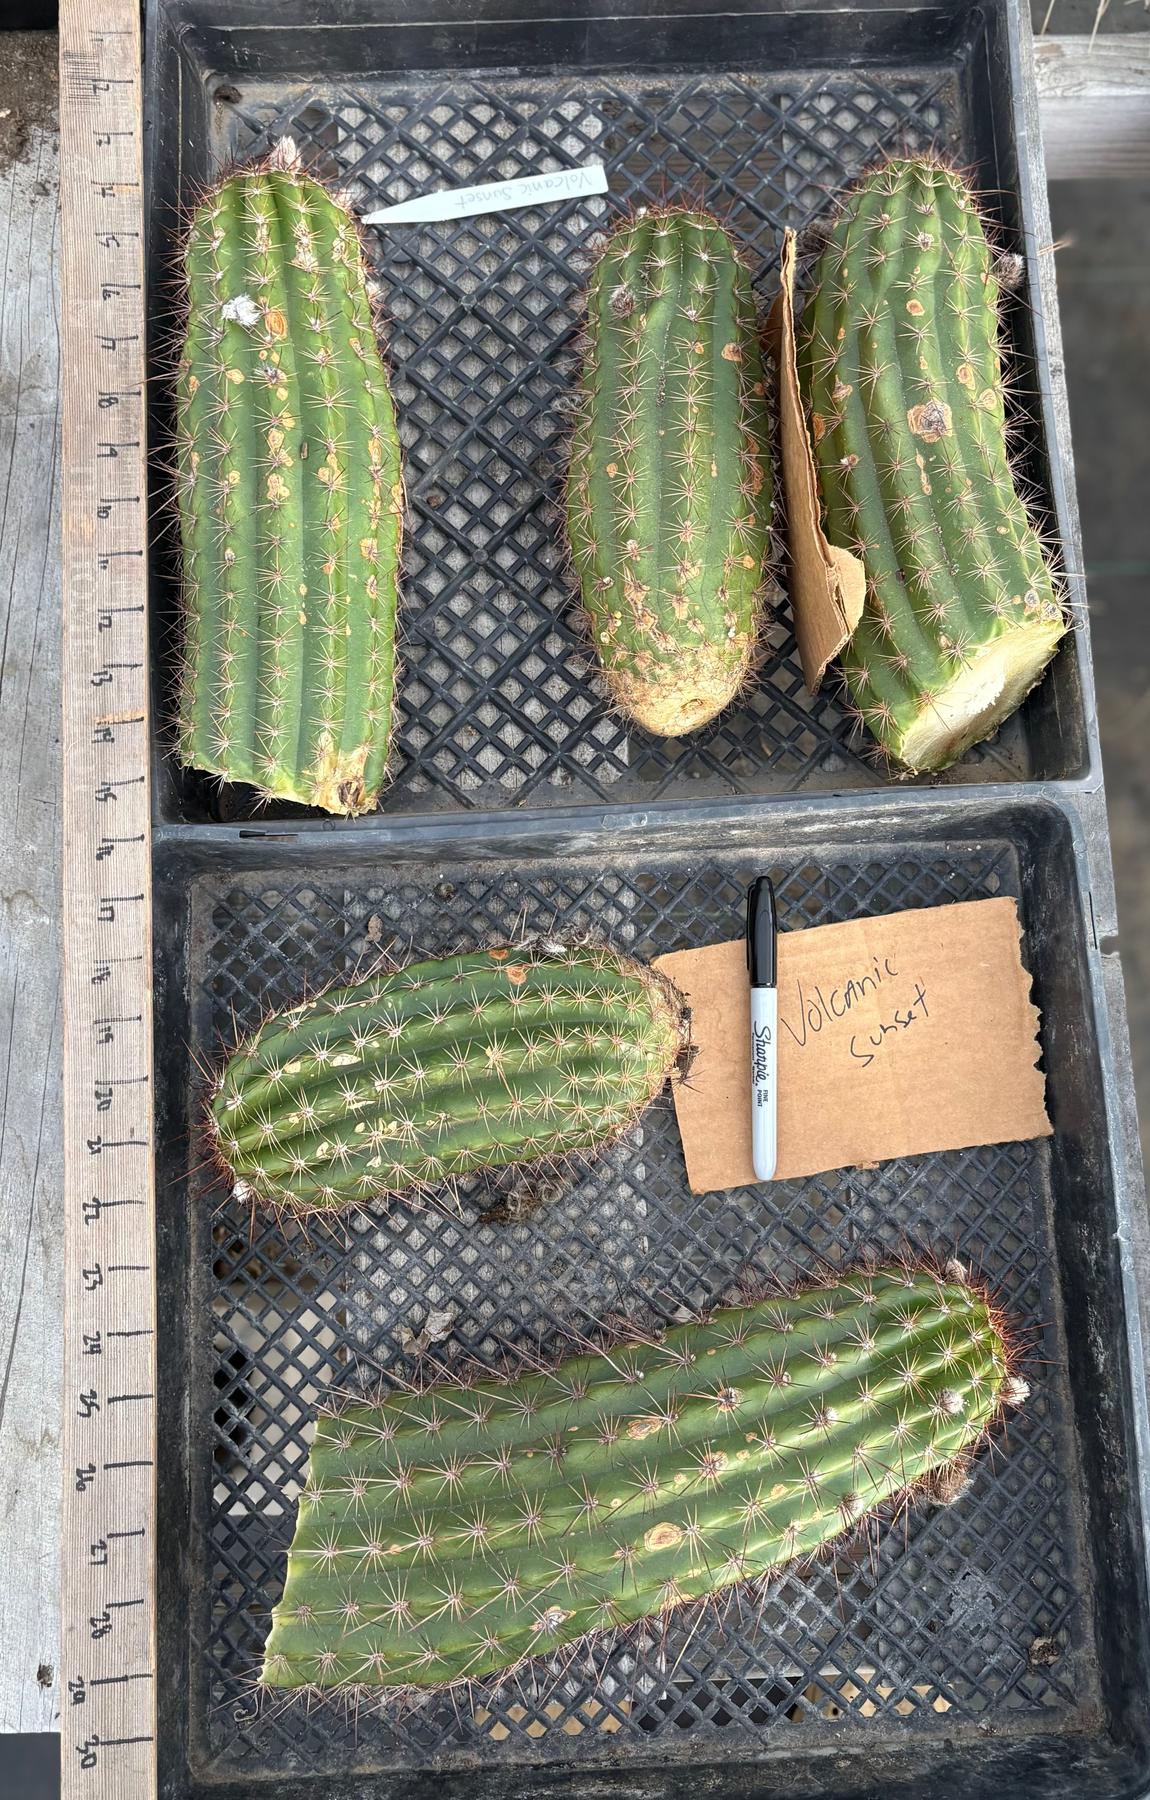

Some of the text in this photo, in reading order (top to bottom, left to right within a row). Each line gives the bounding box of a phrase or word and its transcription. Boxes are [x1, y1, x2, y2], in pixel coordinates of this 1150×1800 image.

[92, 83, 109, 94] 2
[94, 186, 115, 198] 4
[453, 171, 593, 210] Volcanic Sunset
[98, 235, 120, 248] 5
[102, 288, 120, 300] 6
[101, 339, 116, 351] 7
[98, 397, 118, 408] 8
[97, 447, 118, 458] 9
[97, 505, 112, 519] 10
[98, 615, 112, 633] 12
[91, 671, 113, 687] 13
[91, 727, 115, 743] 14
[95, 787, 117, 802] 15
[96, 845, 114, 861] 16
[97, 906, 114, 922] 17
[91, 966, 111, 986] 18
[780, 956, 898, 1046] Volcanic
[850, 978, 929, 1068] Sunset
[96, 1025, 113, 1044] 19
[95, 1088, 113, 1112] 20
[87, 1135, 102, 1155] 21
[82, 1196, 101, 1226] 22
[82, 1263, 103, 1291] 23
[82, 1331, 102, 1355] 24
[77, 1389, 100, 1418] 25
[76, 1463, 96, 1492] 26
[88, 1539, 107, 1566] 27
[90, 1612, 112, 1640] 28
[69, 1675, 86, 1706] 29
[76, 1734, 100, 1769] 30
